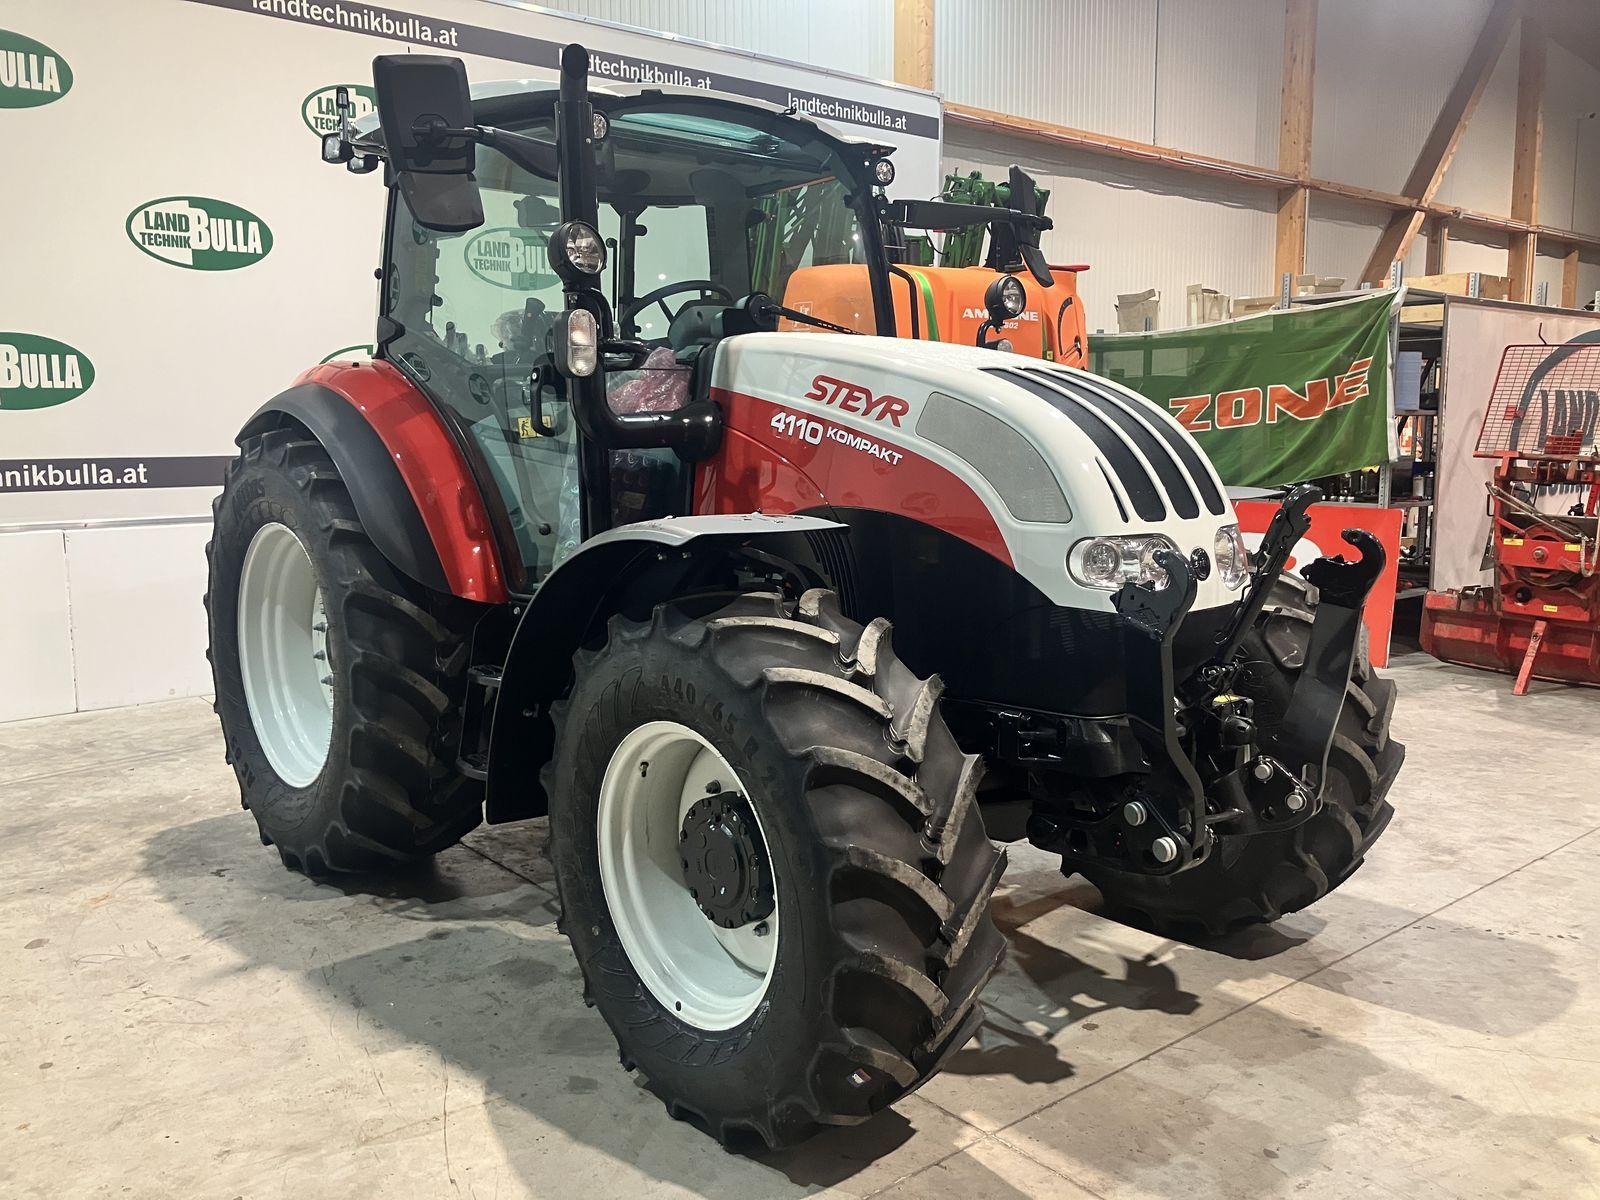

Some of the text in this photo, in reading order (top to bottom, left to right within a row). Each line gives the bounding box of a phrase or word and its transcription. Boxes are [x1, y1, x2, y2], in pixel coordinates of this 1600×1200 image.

[787, 92, 907, 130] landtechnikbulla.at
[139, 231, 192, 249] TECHNIK
[143, 210, 190, 233] LAND
[188, 207, 263, 254] BULLA
[473, 258, 512, 273] TECHNIK
[477, 240, 511, 258] LAND
[510, 237, 558, 275] BULL
[0, 343, 83, 389] BULLA
[804, 374, 910, 428] STEYR
[1169, 355, 1374, 433] ZONE
[770, 411, 904, 466] 4110 KOMPAKT
